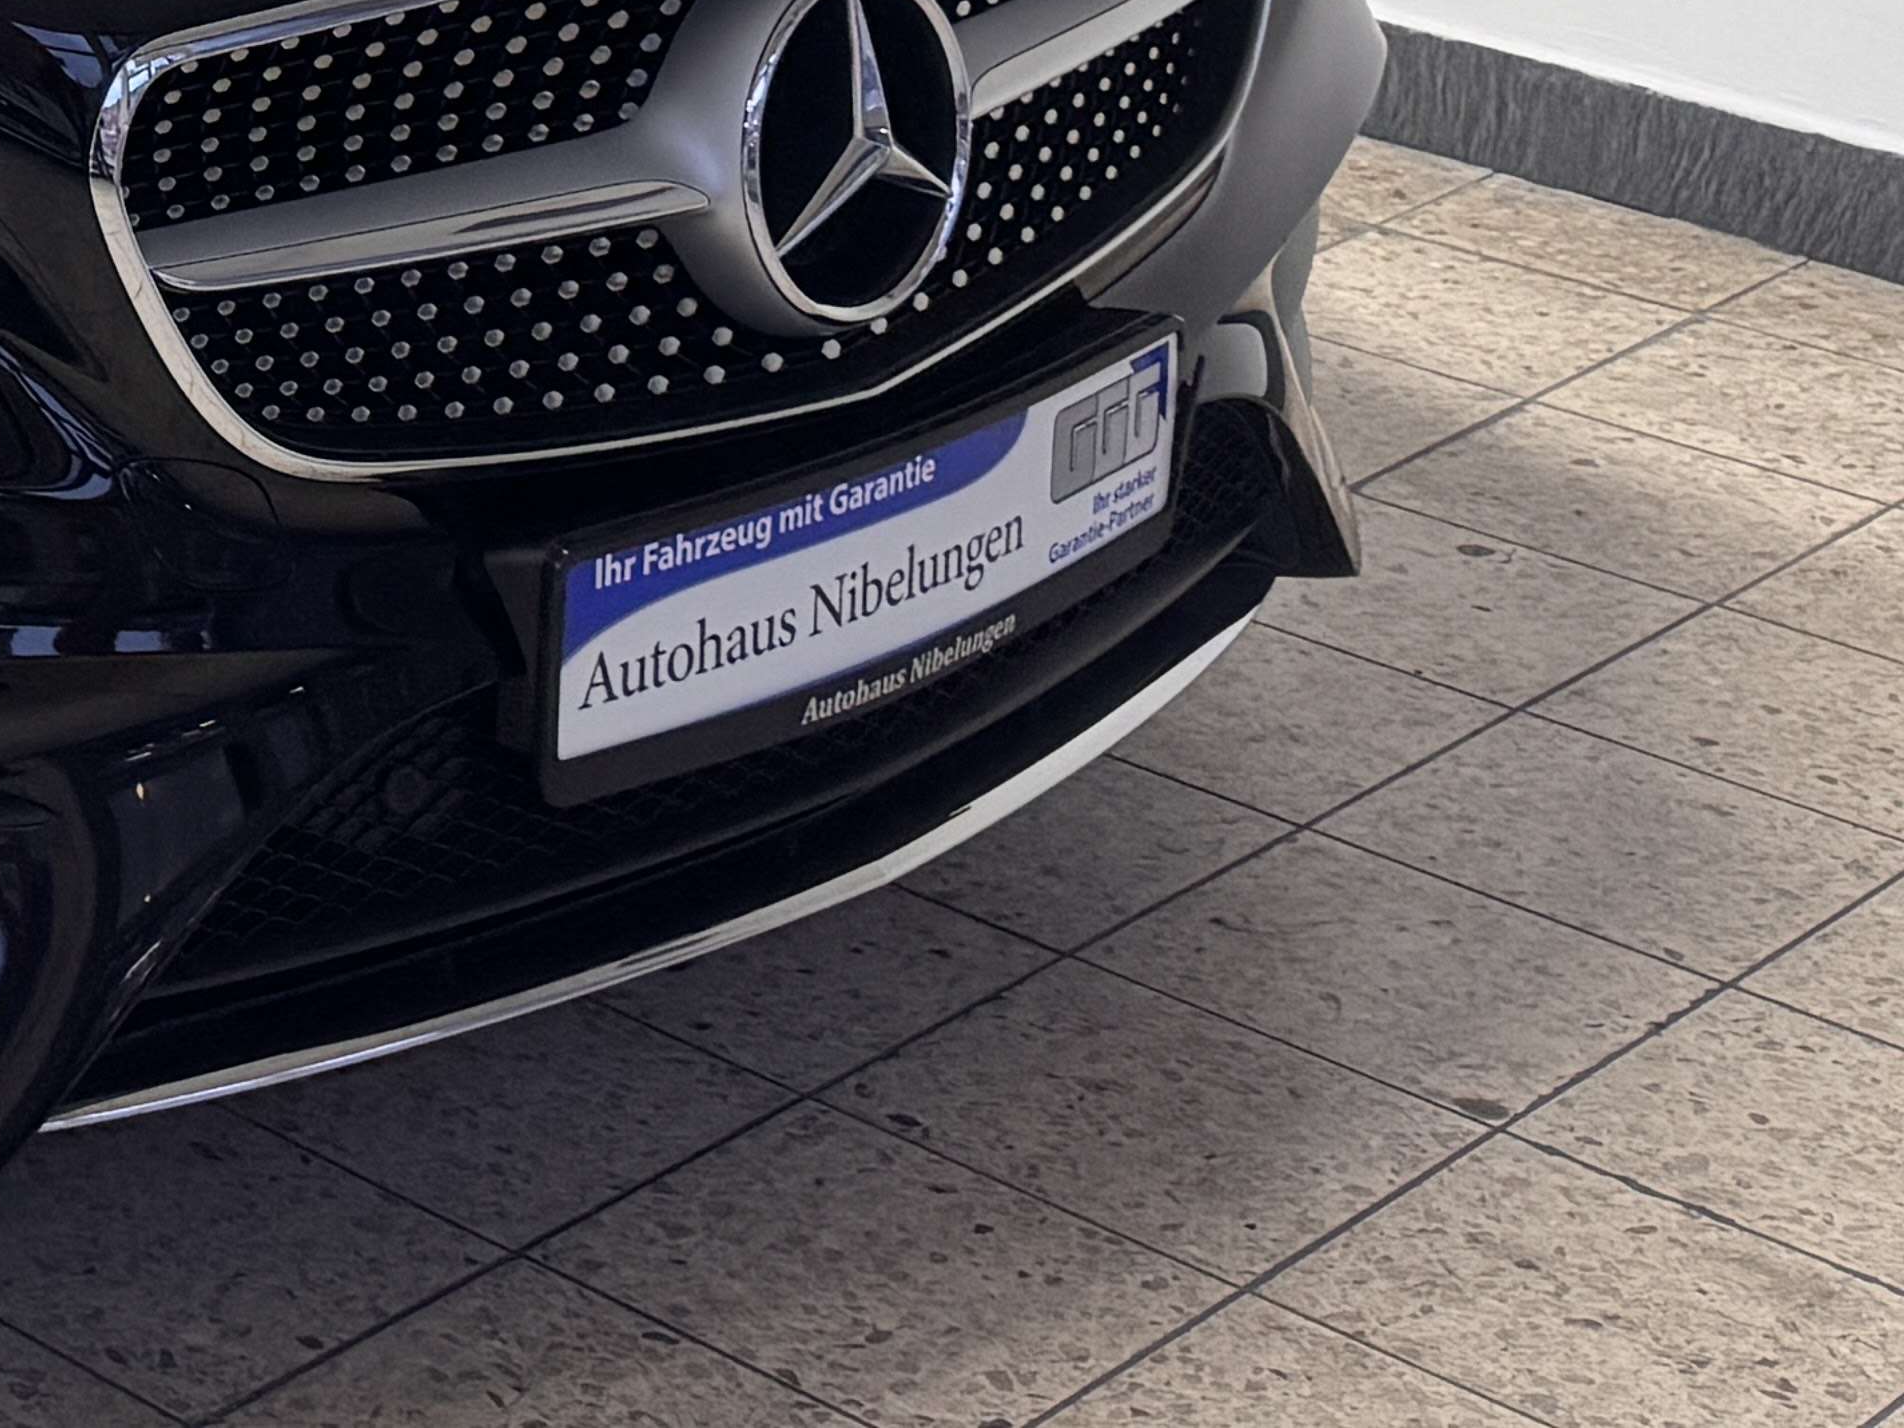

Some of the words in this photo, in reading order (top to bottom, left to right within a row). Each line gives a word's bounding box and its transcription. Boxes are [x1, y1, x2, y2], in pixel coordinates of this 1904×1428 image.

[594, 553, 634, 590] Ihr
[641, 515, 772, 577] Fahrzeug
[778, 493, 824, 532] mit
[828, 454, 937, 516] Garantie
[1048, 493, 1155, 564] Garantie-Partner
[577, 607, 798, 711] Autohaus
[808, 514, 1026, 639] Nibelungen
[800, 667, 908, 726] Autohaus
[909, 613, 1017, 684] Nibelungen
